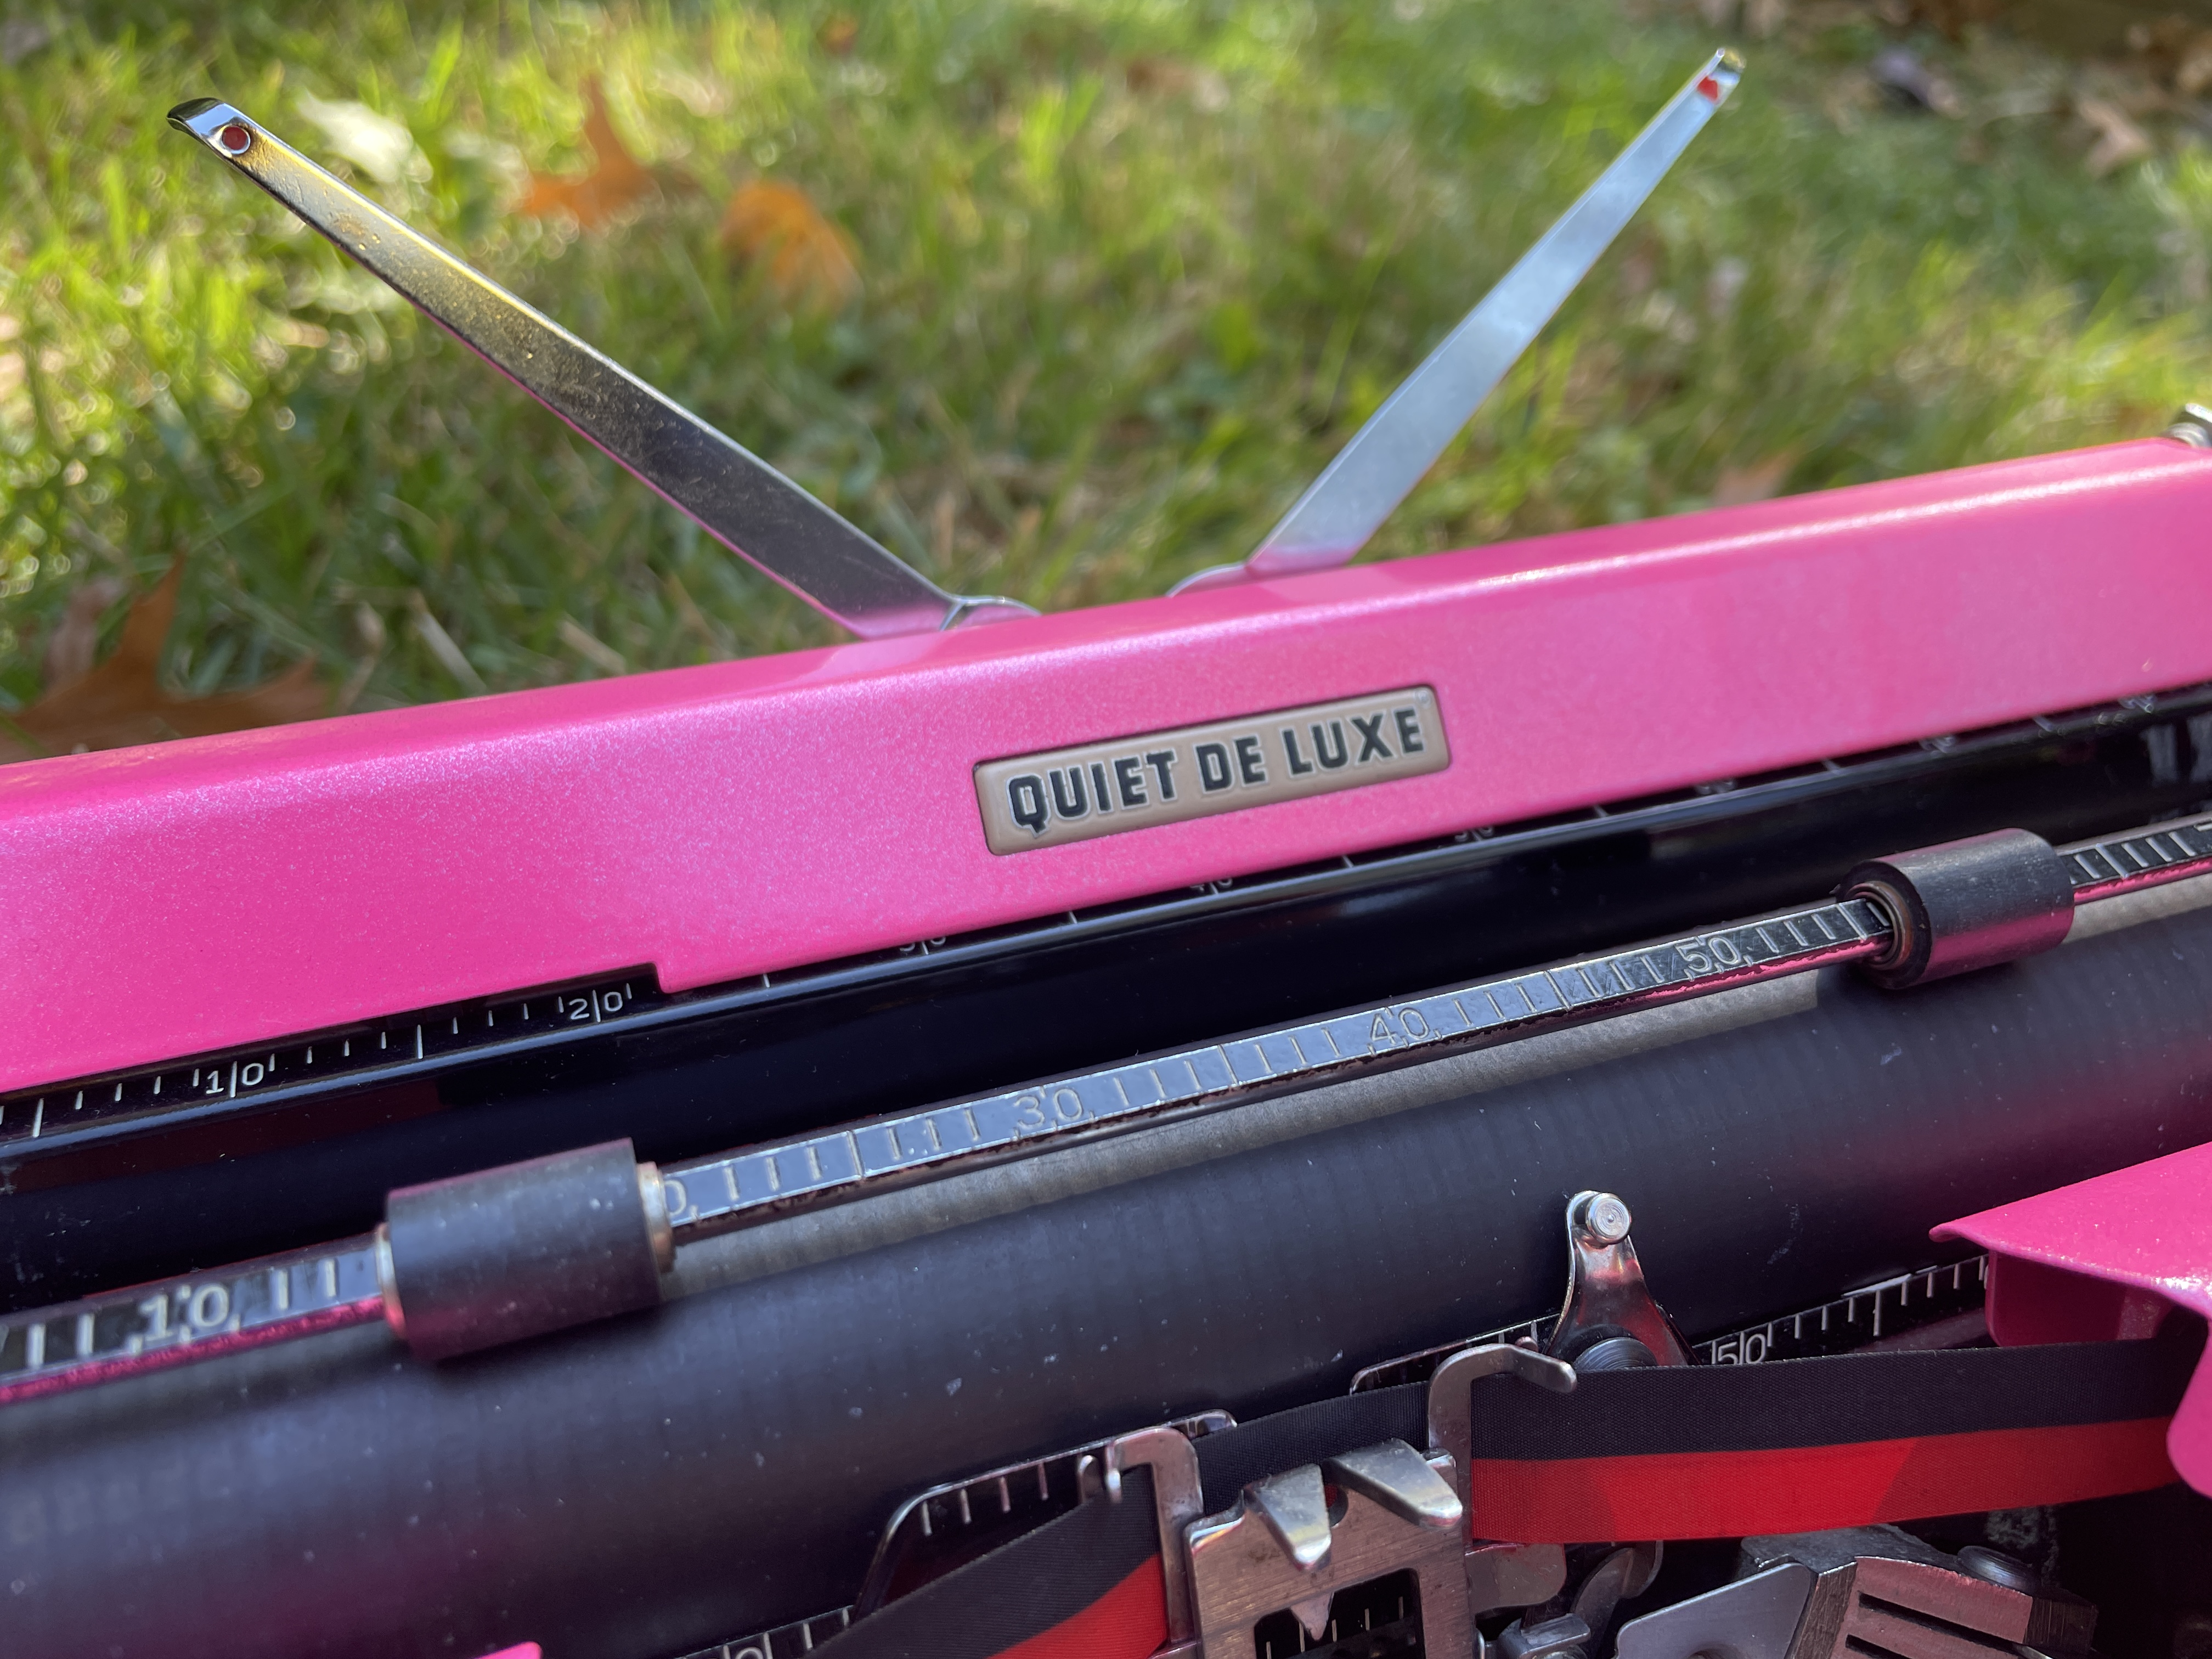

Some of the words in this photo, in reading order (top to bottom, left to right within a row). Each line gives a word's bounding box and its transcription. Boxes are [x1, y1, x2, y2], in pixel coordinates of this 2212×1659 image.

[1007, 750, 1176, 836] QUIET
[1195, 735, 1266, 793] DE
[1282, 707, 1425, 776] LUXE
[138, 1283, 229, 1342] 10
[1014, 1088, 1084, 1130] 30
[1370, 1007, 1430, 1044] 40
[1675, 936, 1741, 973] 50
